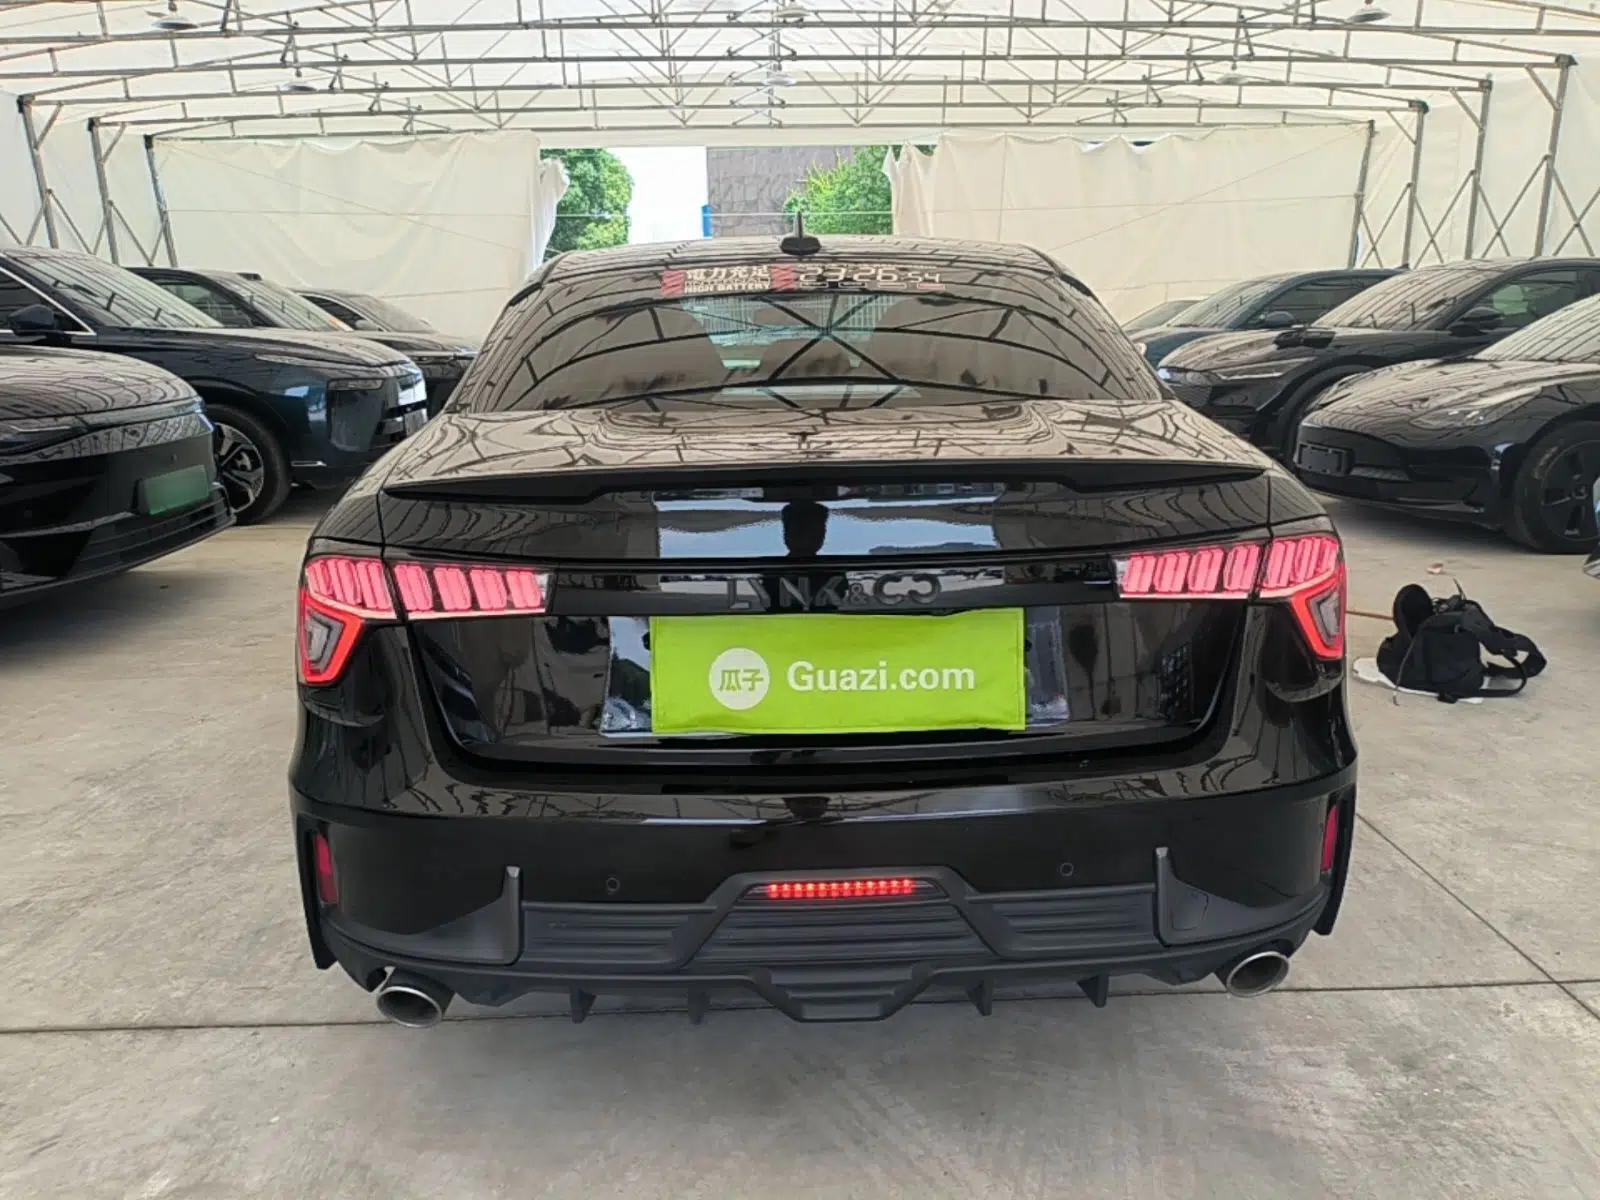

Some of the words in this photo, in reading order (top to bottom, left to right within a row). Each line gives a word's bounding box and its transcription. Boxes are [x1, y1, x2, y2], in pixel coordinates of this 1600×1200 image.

[684, 285, 714, 294] HIGH
[716, 282, 771, 292] BATTERY
[719, 668, 764, 692] 瓜子
[787, 660, 976, 692] Guazi.com
